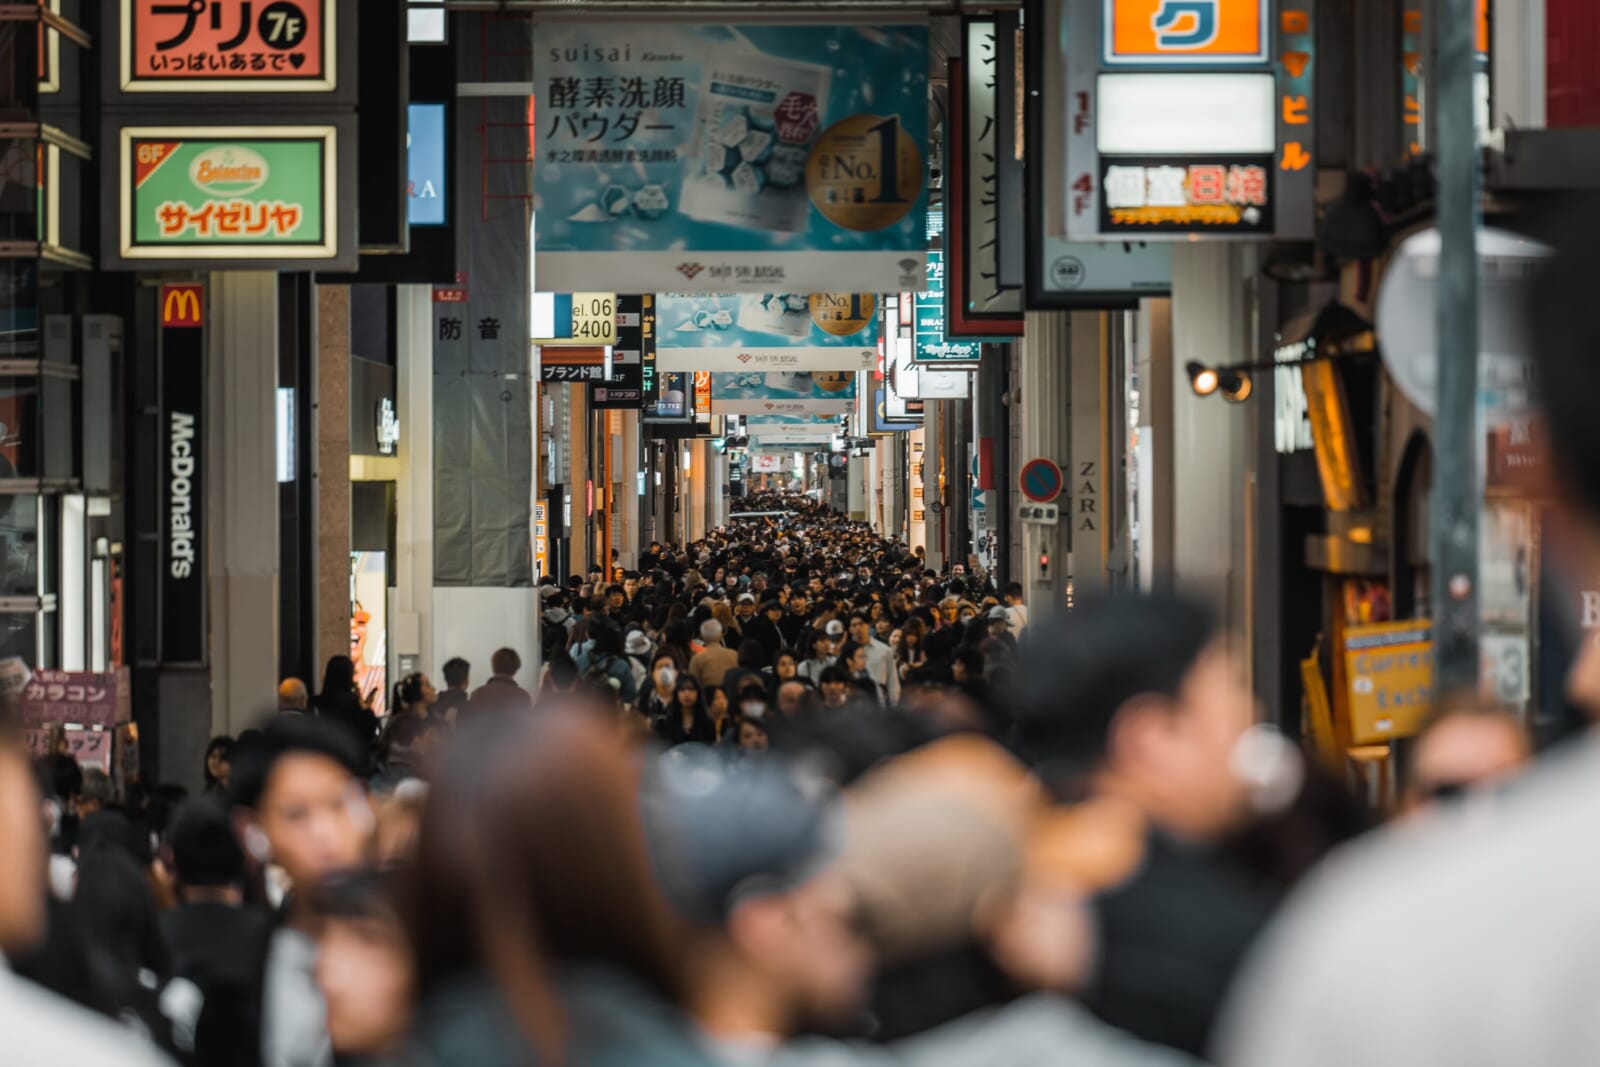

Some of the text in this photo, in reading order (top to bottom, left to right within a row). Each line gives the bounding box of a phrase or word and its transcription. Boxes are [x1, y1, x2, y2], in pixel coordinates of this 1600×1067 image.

[151, 0, 252, 52] プリ
[267, 12, 301, 42] 7F
[150, 52, 288, 71] いっぱいあるで
[549, 43, 631, 63] suisai
[548, 76, 685, 109] 酵素洗顔
[546, 111, 675, 142] パウダー
[138, 144, 165, 164] 6F
[833, 154, 877, 180] No.
[866, 115, 909, 204] 1
[158, 202, 302, 237] サイゼリヤ
[591, 299, 612, 316] 06
[573, 320, 612, 338] 2400
[544, 366, 602, 379] ブランド館
[171, 411, 194, 579] McDonald's
[1079, 462, 1096, 531] ZARA
[27, 684, 106, 702] カラコン
